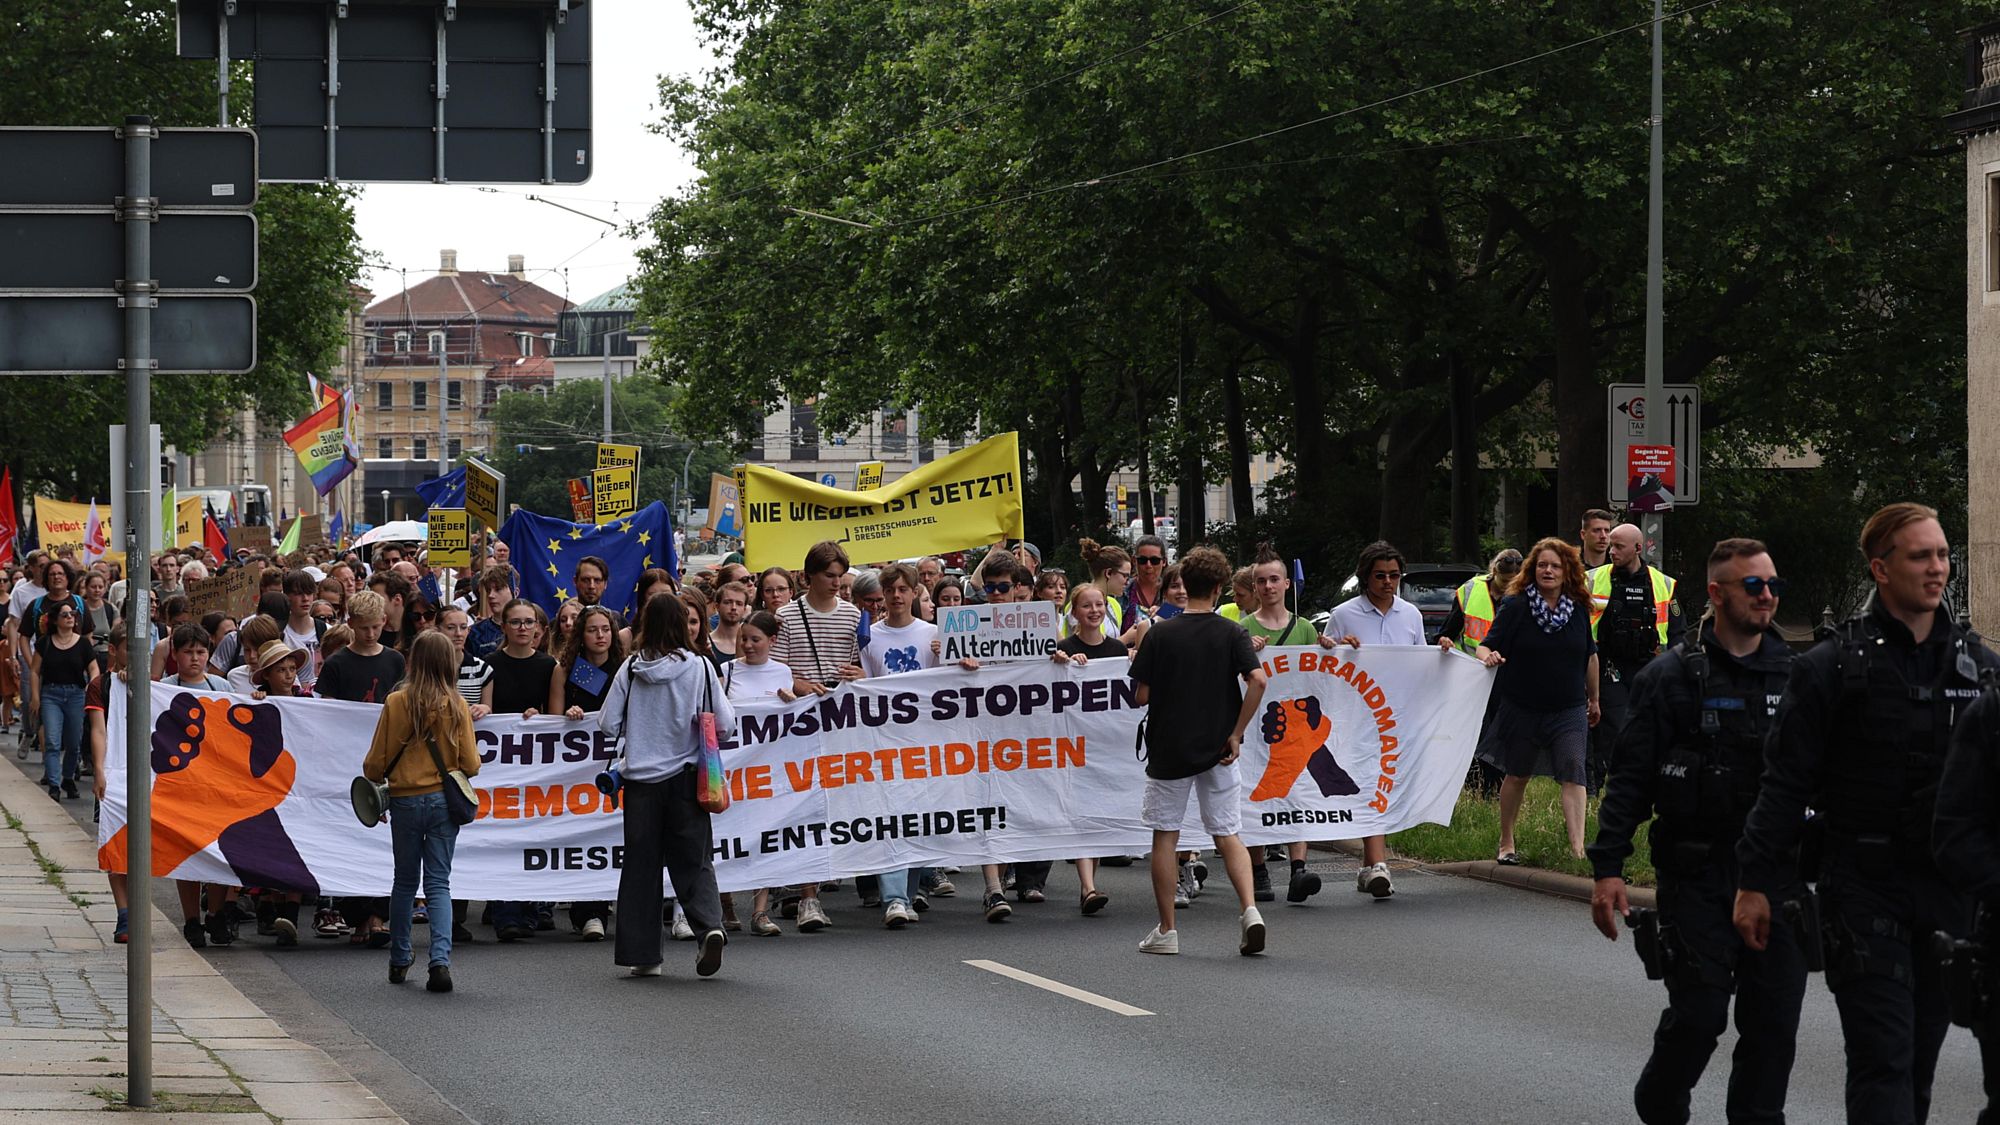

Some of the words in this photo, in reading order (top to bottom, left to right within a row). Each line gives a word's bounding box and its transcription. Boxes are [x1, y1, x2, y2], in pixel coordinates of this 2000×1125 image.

[600, 448, 615, 457] NIE
[600, 457, 634, 467] WIEDER
[467, 464, 480, 477] NIE
[861, 468, 870, 476] NIE
[597, 474, 611, 484] NIE
[859, 475, 880, 485] WIEDER
[597, 480, 630, 493] WIEDER
[597, 492, 612, 502] IST
[749, 502, 781, 523] NIE
[790, 502, 874, 522] WIEDER
[881, 489, 921, 514] IST
[929, 472, 1014, 506] JETZT!
[597, 499, 629, 511] JETZT!
[430, 514, 445, 523] NIE
[45, 520, 81, 533] Verbot
[430, 523, 466, 531] WIEDER
[853, 516, 938, 534] STAATSSCHAUSPIEL
[430, 531, 446, 539] IST
[855, 530, 892, 542] DRESDEN
[429, 539, 464, 547] JETZT!
[190, 591, 220, 607] gegen
[945, 630, 1057, 660] Alternative
[1262, 654, 1290, 678] IE
[1299, 652, 1399, 814] BRANDMAUER
[785, 735, 1086, 794] VERTEIDIGEN
[1261, 809, 1353, 827] DRESDEN
[760, 806, 1007, 855] ENTSCHEIDET!
